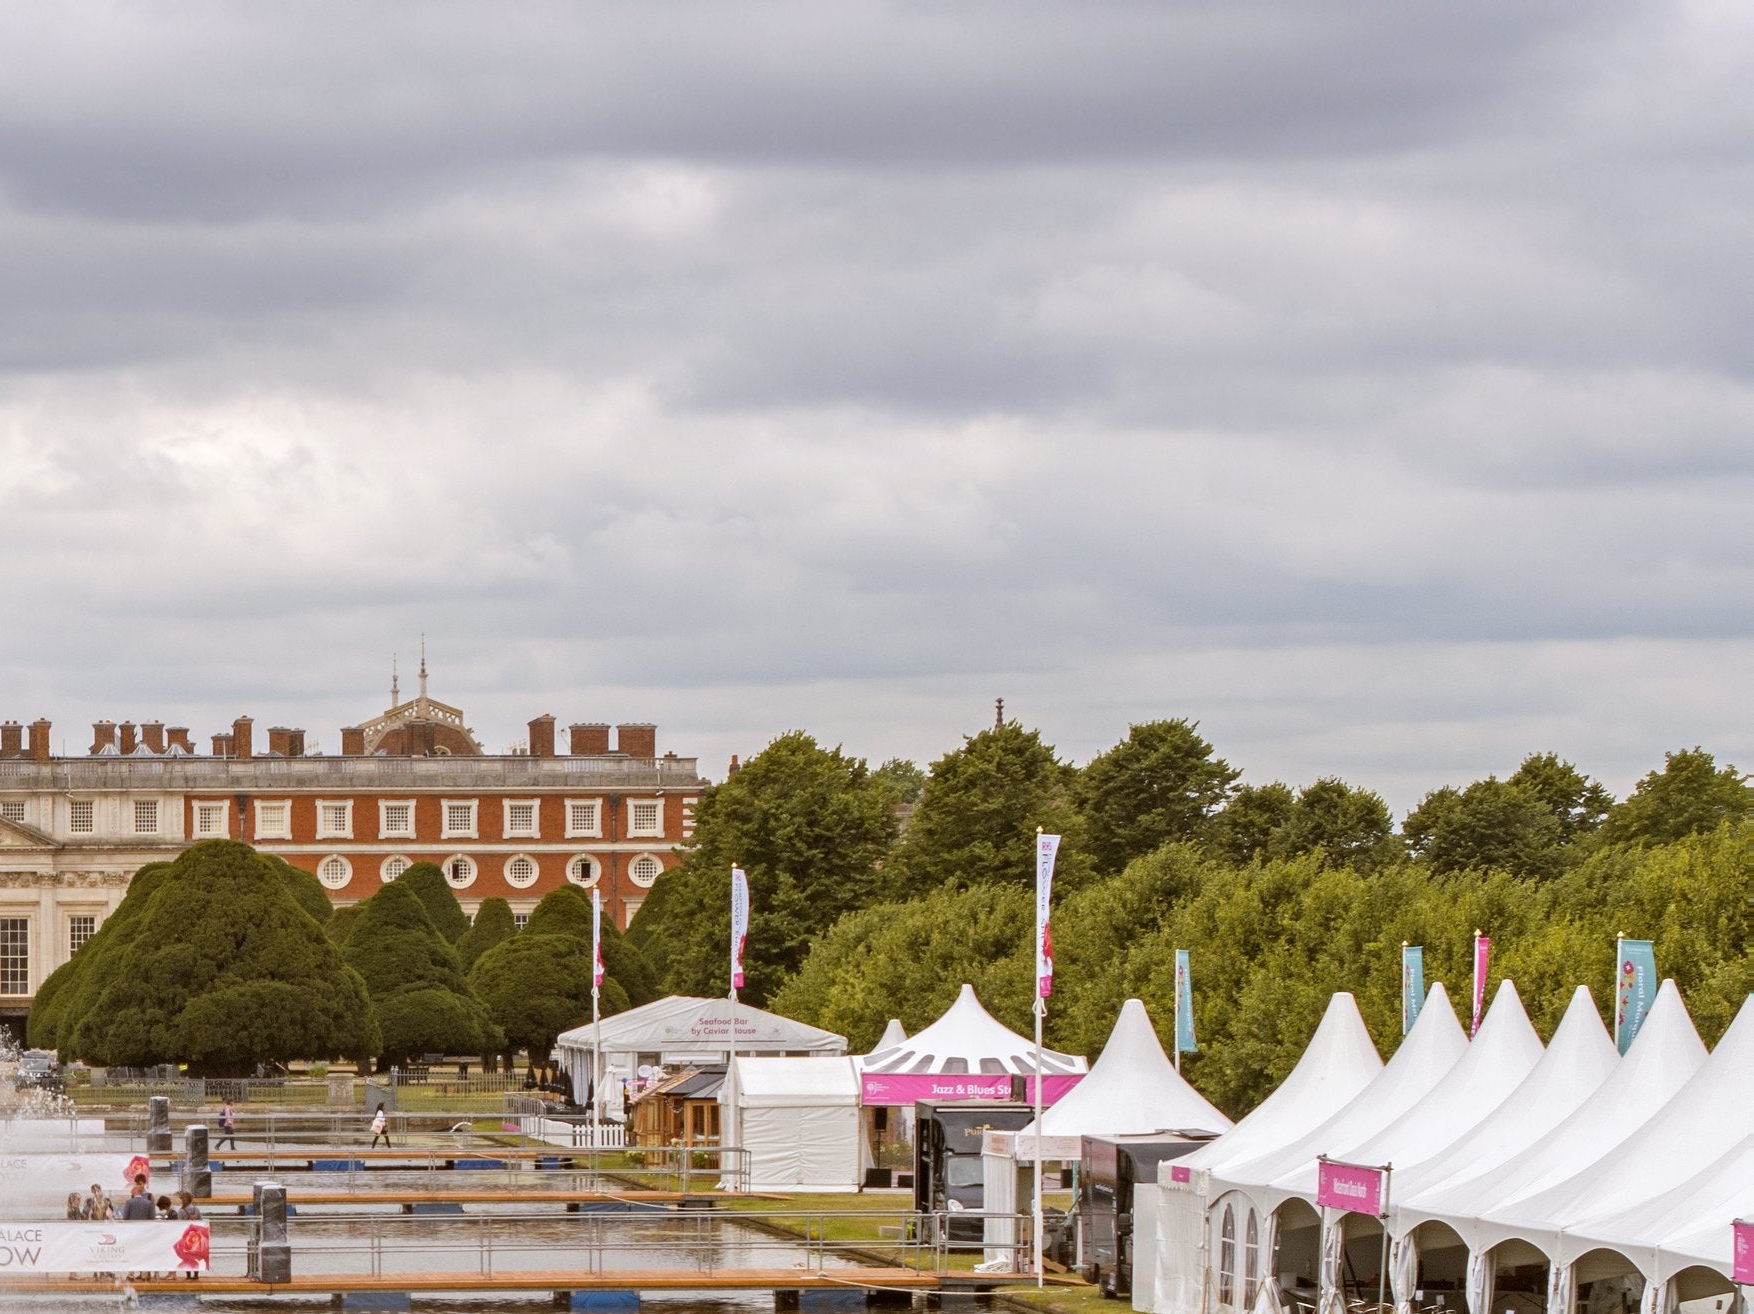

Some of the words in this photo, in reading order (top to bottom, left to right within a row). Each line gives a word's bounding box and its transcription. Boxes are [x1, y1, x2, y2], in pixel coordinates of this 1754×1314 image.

[1637, 965, 1645, 998] Floral
[699, 1017, 732, 1025] Seafood
[734, 1017, 748, 1025] Bar
[691, 1027, 701, 1035] by
[931, 1084, 954, 1095] Jazz
[956, 1084, 965, 1095] &
[968, 1084, 995, 1095] Blues
